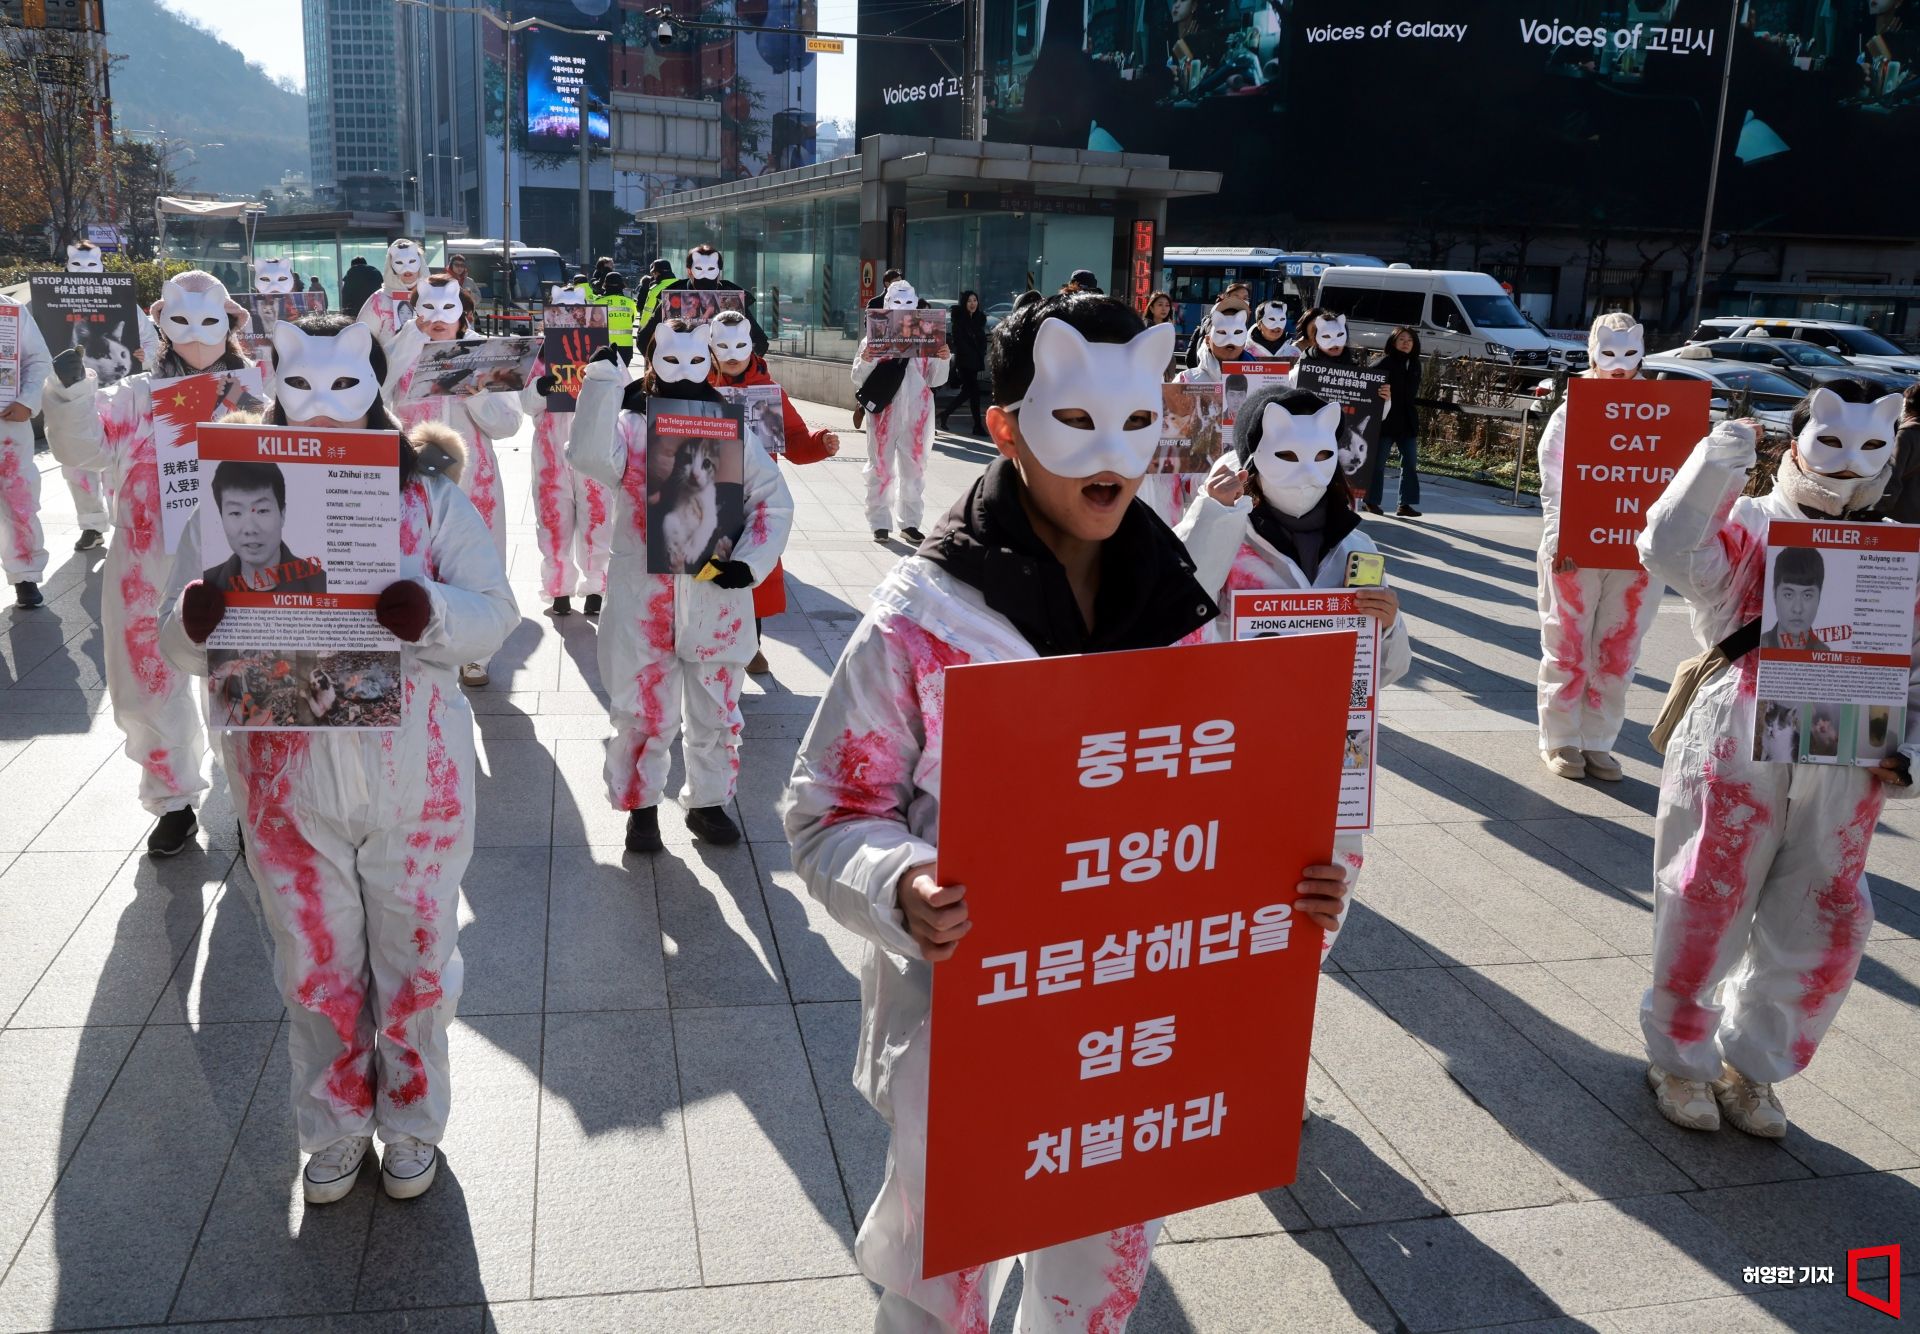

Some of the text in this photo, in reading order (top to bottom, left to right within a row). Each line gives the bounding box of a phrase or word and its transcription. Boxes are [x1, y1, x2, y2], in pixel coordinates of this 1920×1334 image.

[1306, 20, 1468, 43] Voices of Galaxy
[1520, 18, 1715, 56] Voices of 고민시
[883, 84, 926, 105] Voices
[929, 76, 944, 98] of
[1286, 264, 1300, 274] 507
[32, 276, 132, 286] #STOP ANIMAL ABUSE
[1302, 364, 1386, 382] #STOP ANIMAL ABUSE
[1604, 402, 1670, 420] STOP
[668, 418, 693, 426] Telegram
[723, 422, 736, 430] rings
[258, 436, 346, 458] KILLER 杀手
[1610, 434, 1661, 452] CAT
[163, 459, 198, 476] 我希望
[328, 470, 338, 478] Xu
[340, 471, 361, 479] Zhihui
[1576, 464, 1679, 484] TORTUR
[166, 478, 200, 494] 人受到
[166, 497, 198, 509] #STOP
[1616, 498, 1639, 514] IN
[1812, 528, 1860, 545] KILLER
[228, 556, 322, 593] WANTED
[273, 594, 312, 606] VICTIM
[1254, 600, 1279, 612] CAT
[1280, 600, 1324, 611] KILLER
[1250, 616, 1366, 630] ZHONG AICHENG 钟艾程
[1779, 624, 1853, 649] WANTED
[1812, 652, 1842, 663] VICTIM
[1077, 719, 1236, 789] 중국은
[1060, 820, 1219, 893] 고양이
[977, 903, 1293, 1006] 고문살해단을
[1077, 1014, 1177, 1081] 엄중
[1024, 1092, 1228, 1181] 처벌하라
